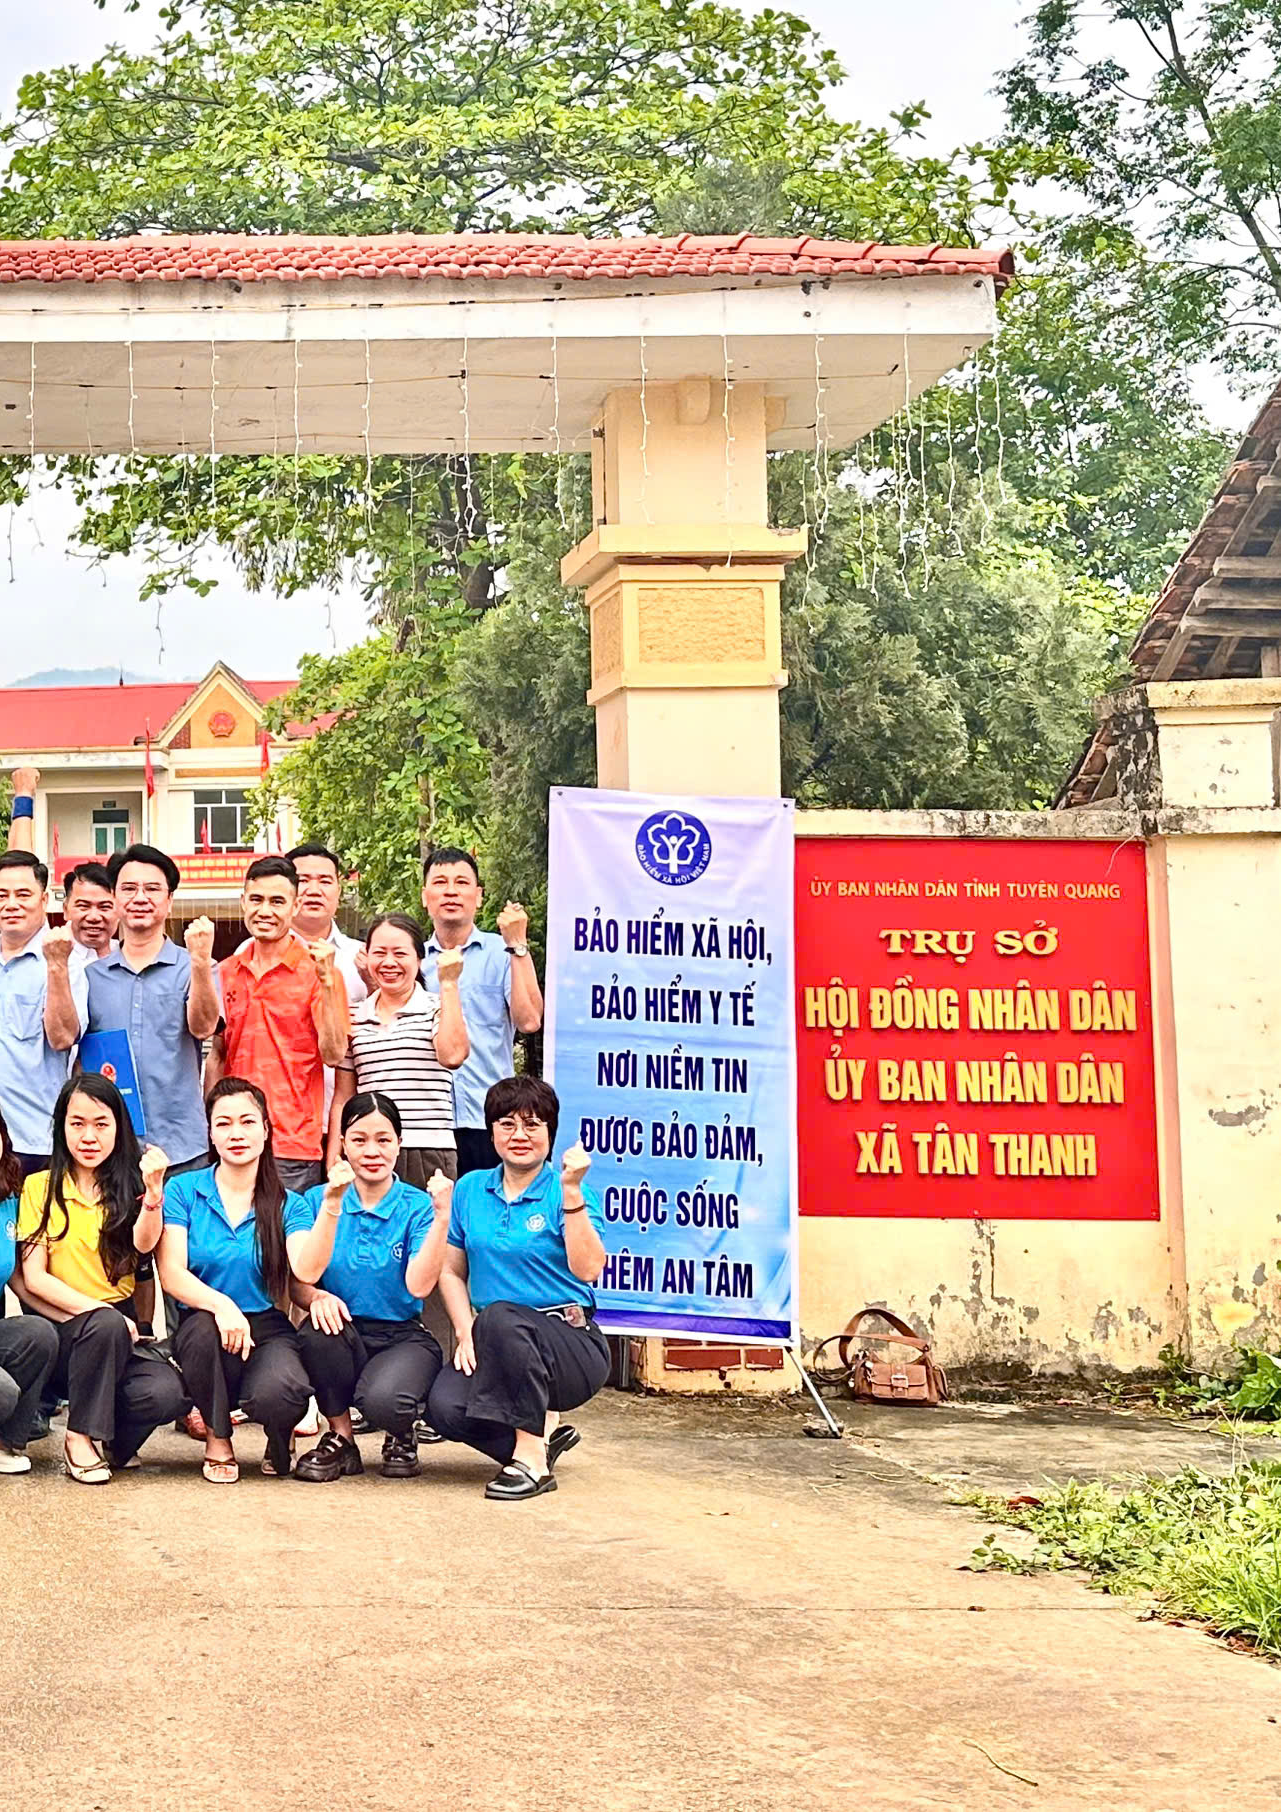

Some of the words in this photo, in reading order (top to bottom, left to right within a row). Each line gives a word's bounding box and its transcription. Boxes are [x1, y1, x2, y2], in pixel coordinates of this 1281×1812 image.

[810, 875, 832, 896] ỦY
[837, 881, 869, 897] BAN
[874, 878, 919, 897] NHÂN
[925, 879, 958, 897] DÂN
[963, 877, 1000, 898] TỈNH
[1007, 880, 1058, 898] TUYÊN
[1064, 883, 1121, 899] QUANG
[574, 906, 619, 954] BẢO
[626, 906, 684, 956] HIỂM
[691, 917, 721, 959] XÃ
[728, 918, 773, 968] HỘI,
[879, 929, 975, 963] TRỤ
[994, 919, 1059, 955] SỞ
[591, 973, 637, 1021] BẢO
[644, 974, 702, 1024] HIỂM
[709, 990, 722, 1025] Y
[729, 981, 756, 1026] TẾ
[804, 976, 860, 1037] HỘI
[869, 974, 960, 1030] ĐỒNG
[968, 979, 1061, 1031] NHÂN
[1069, 980, 1137, 1032] DÂN
[597, 1050, 637, 1088] NƠI
[646, 1044, 704, 1091] NIỀM
[712, 1057, 748, 1093] TIN
[824, 1044, 866, 1101] ỦY
[878, 1059, 947, 1102] BAN
[955, 1052, 1048, 1103] NHÂN
[1055, 1053, 1124, 1104] DÂN
[580, 1115, 643, 1163] ĐƯỢC
[651, 1110, 697, 1159] BẢO
[705, 1113, 763, 1167] ĐẢM,
[855, 1123, 903, 1175] XÃ
[912, 1123, 979, 1176] TÂN
[988, 1133, 1097, 1177] THANH
[604, 1181, 668, 1232] CUỘC
[676, 1179, 739, 1229] SỐNG
[593, 1248, 654, 1292] HÊM
[661, 1258, 694, 1295] AN
[702, 1254, 753, 1298] TÂM
